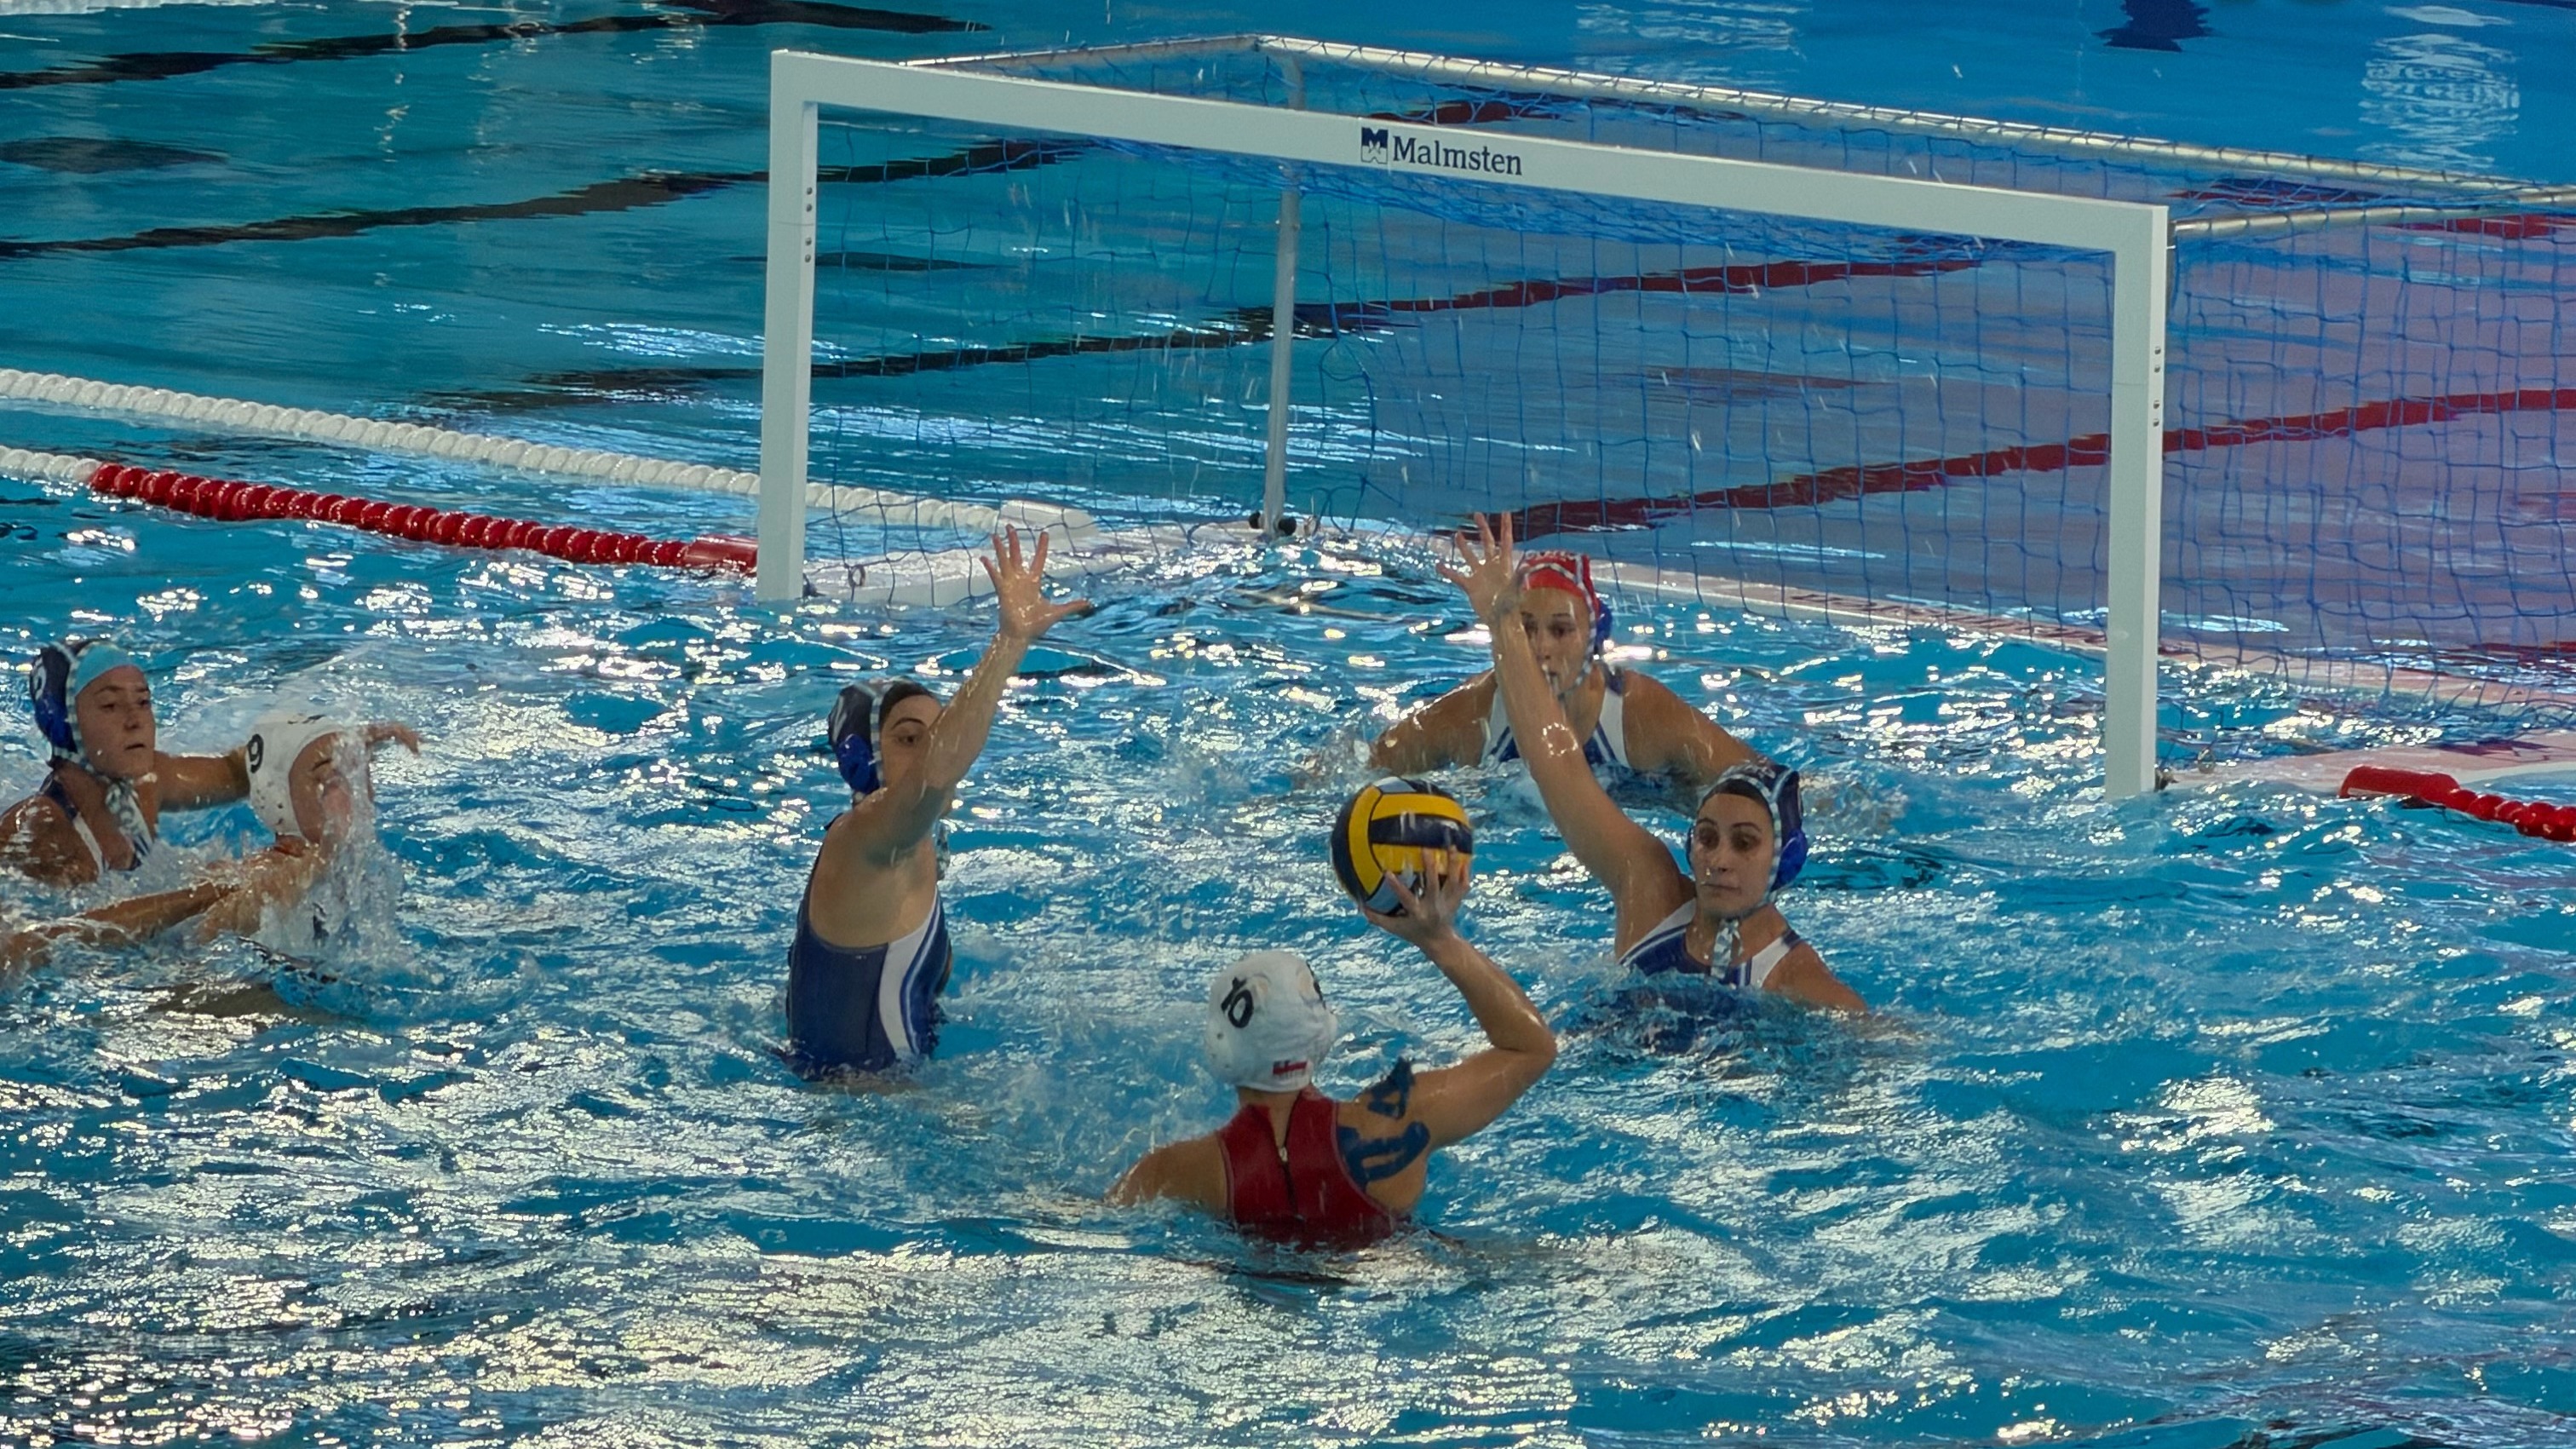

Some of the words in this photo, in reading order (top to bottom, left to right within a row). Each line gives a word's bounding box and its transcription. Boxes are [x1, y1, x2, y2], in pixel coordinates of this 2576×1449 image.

[1393, 135, 1522, 175] Malmsten
[247, 733, 264, 773] 9
[1221, 976, 1254, 1028] 10
